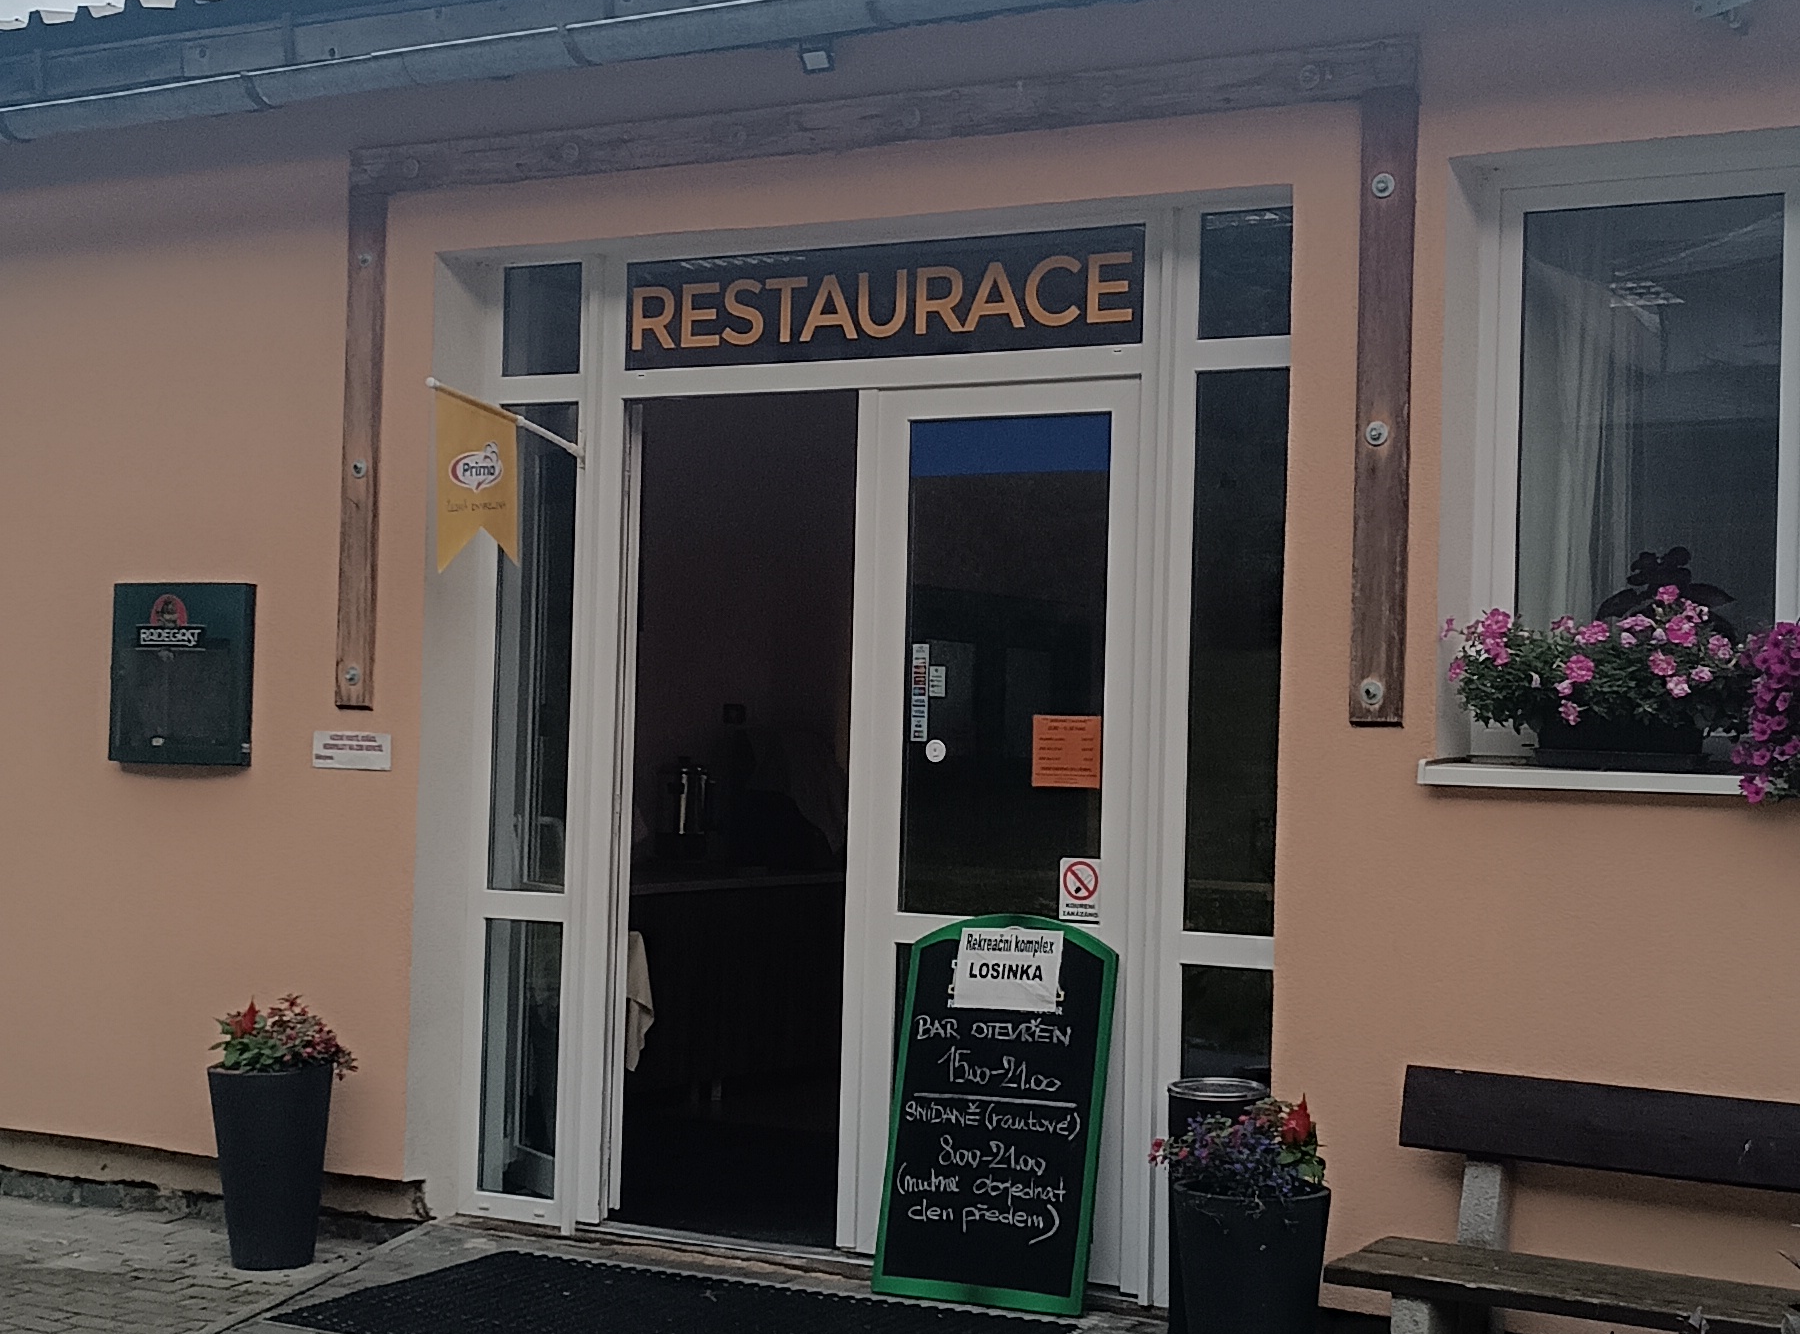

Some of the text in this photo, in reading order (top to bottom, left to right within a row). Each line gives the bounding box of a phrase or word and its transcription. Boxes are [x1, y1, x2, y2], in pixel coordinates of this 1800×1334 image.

[631, 251, 1134, 351] RESTAURACE
[140, 629, 202, 646] RADEGAST
[966, 933, 1055, 958] Rekreační komplex
[969, 962, 1043, 981] LOSINKA
[914, 1015, 1072, 1046] BAR OTEVŘEN
[972, 1173, 1067, 1207] objednat
[908, 1198, 1060, 1245] den předem)
